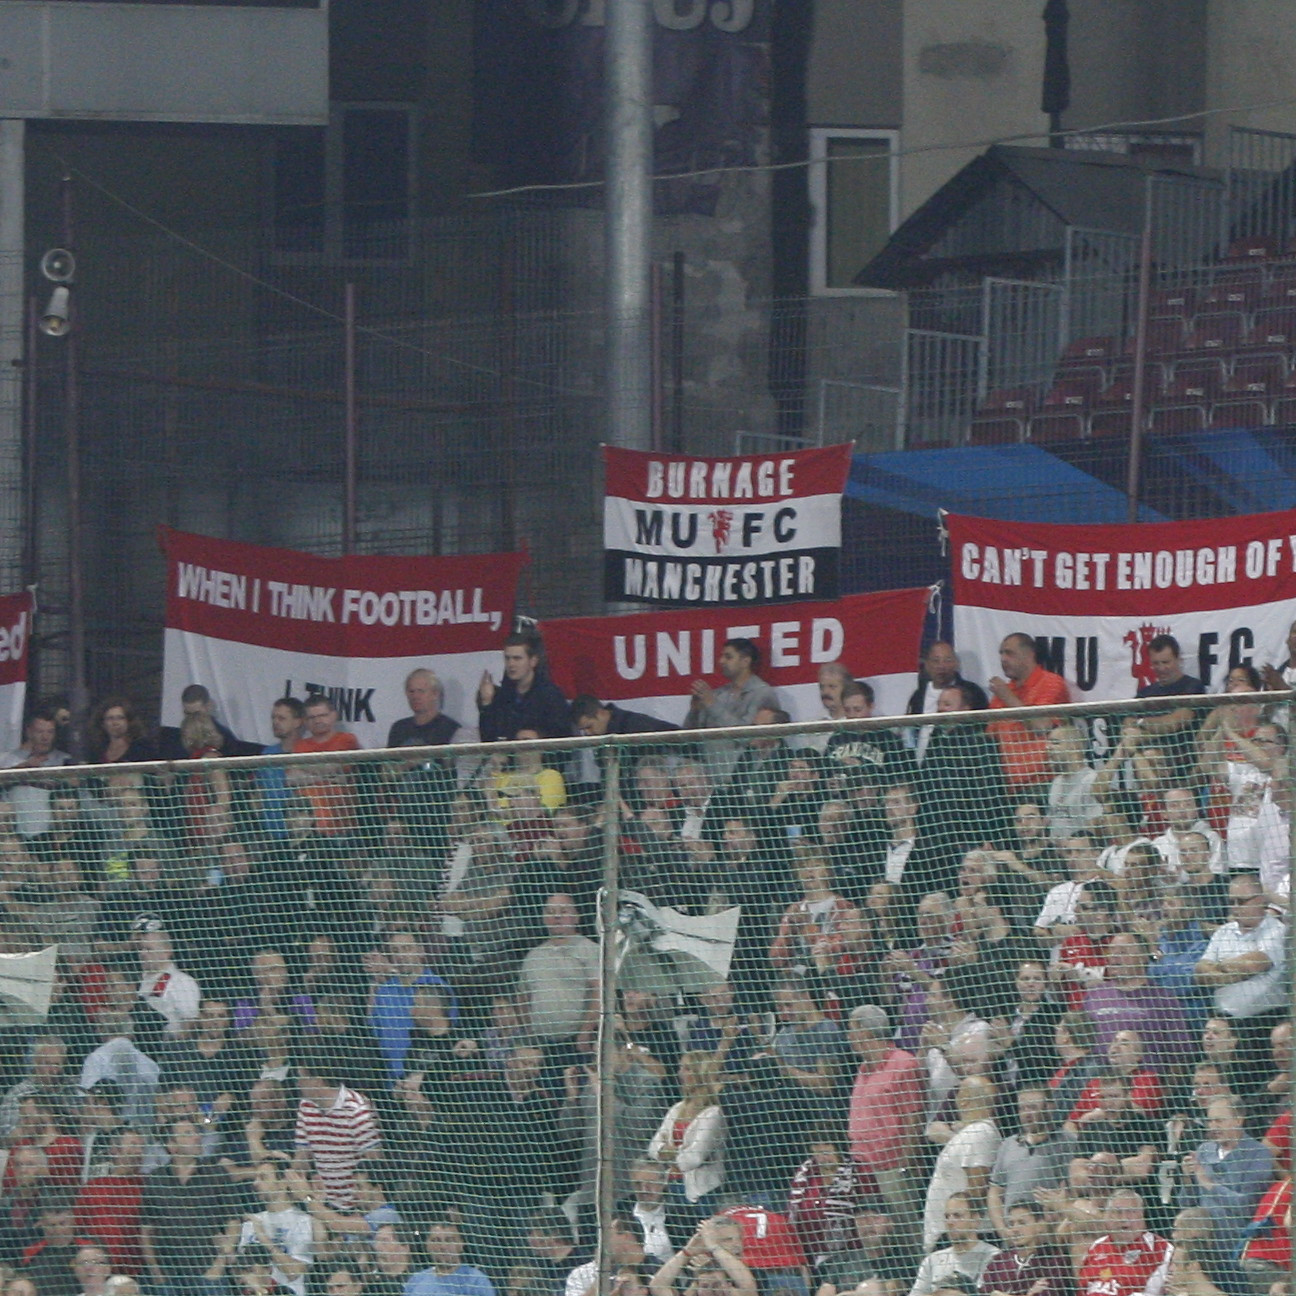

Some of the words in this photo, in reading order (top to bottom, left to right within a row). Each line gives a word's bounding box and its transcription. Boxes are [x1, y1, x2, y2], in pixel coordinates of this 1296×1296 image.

[646, 458, 796, 499] BURNAGE
[624, 556, 816, 601] MANCHESTER
[961, 542, 1049, 587] CAN'T
[1054, 552, 1111, 591] GET
[1116, 544, 1238, 591] ENOUGH
[1245, 538, 1283, 579] OF
[178, 560, 247, 608] WHEN
[252, 582, 259, 613] I
[267, 579, 335, 623] THINK
[341, 588, 502, 632] FOOTBALL,
